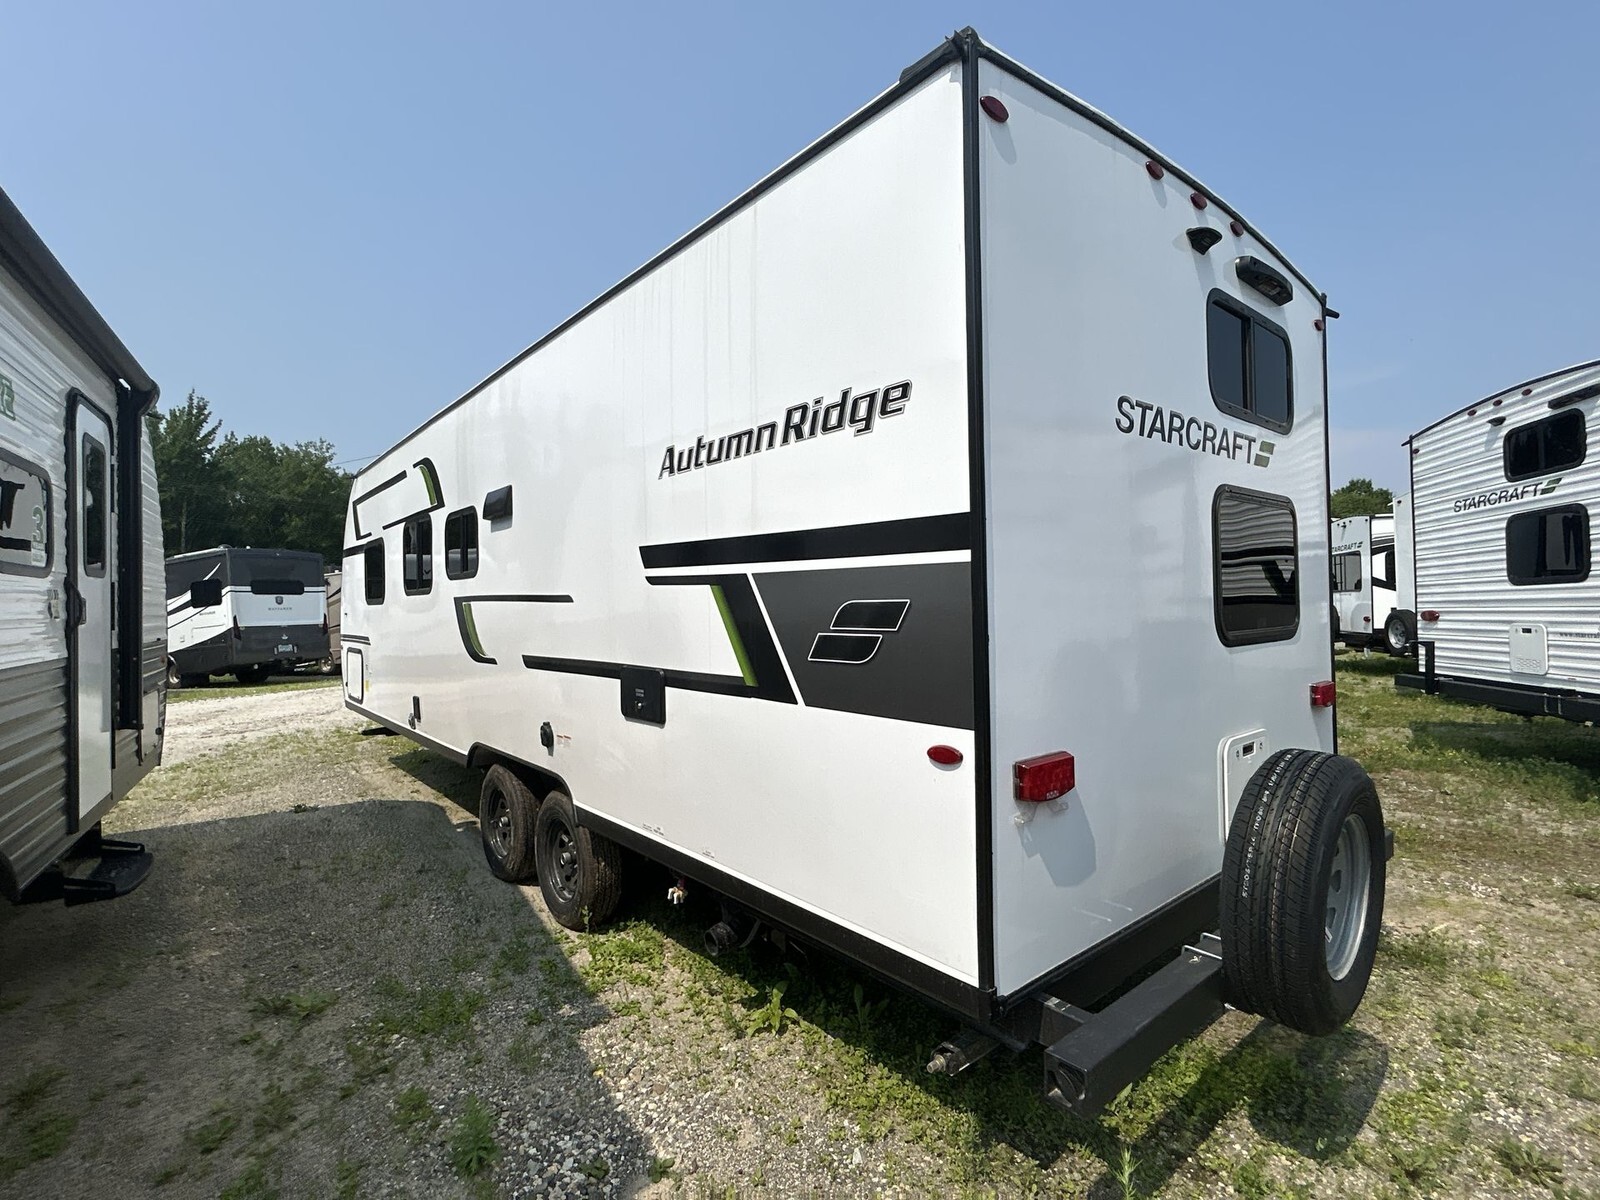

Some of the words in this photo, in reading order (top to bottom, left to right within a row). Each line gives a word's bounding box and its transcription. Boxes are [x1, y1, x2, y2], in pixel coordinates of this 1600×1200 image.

[658, 421, 778, 480] Autumn
[780, 379, 912, 447] Ridge
[1115, 395, 1256, 464] STARCRAFT
[1453, 482, 1543, 513] STARCRAFT
[1331, 542, 1357, 552] TARCRAFT
